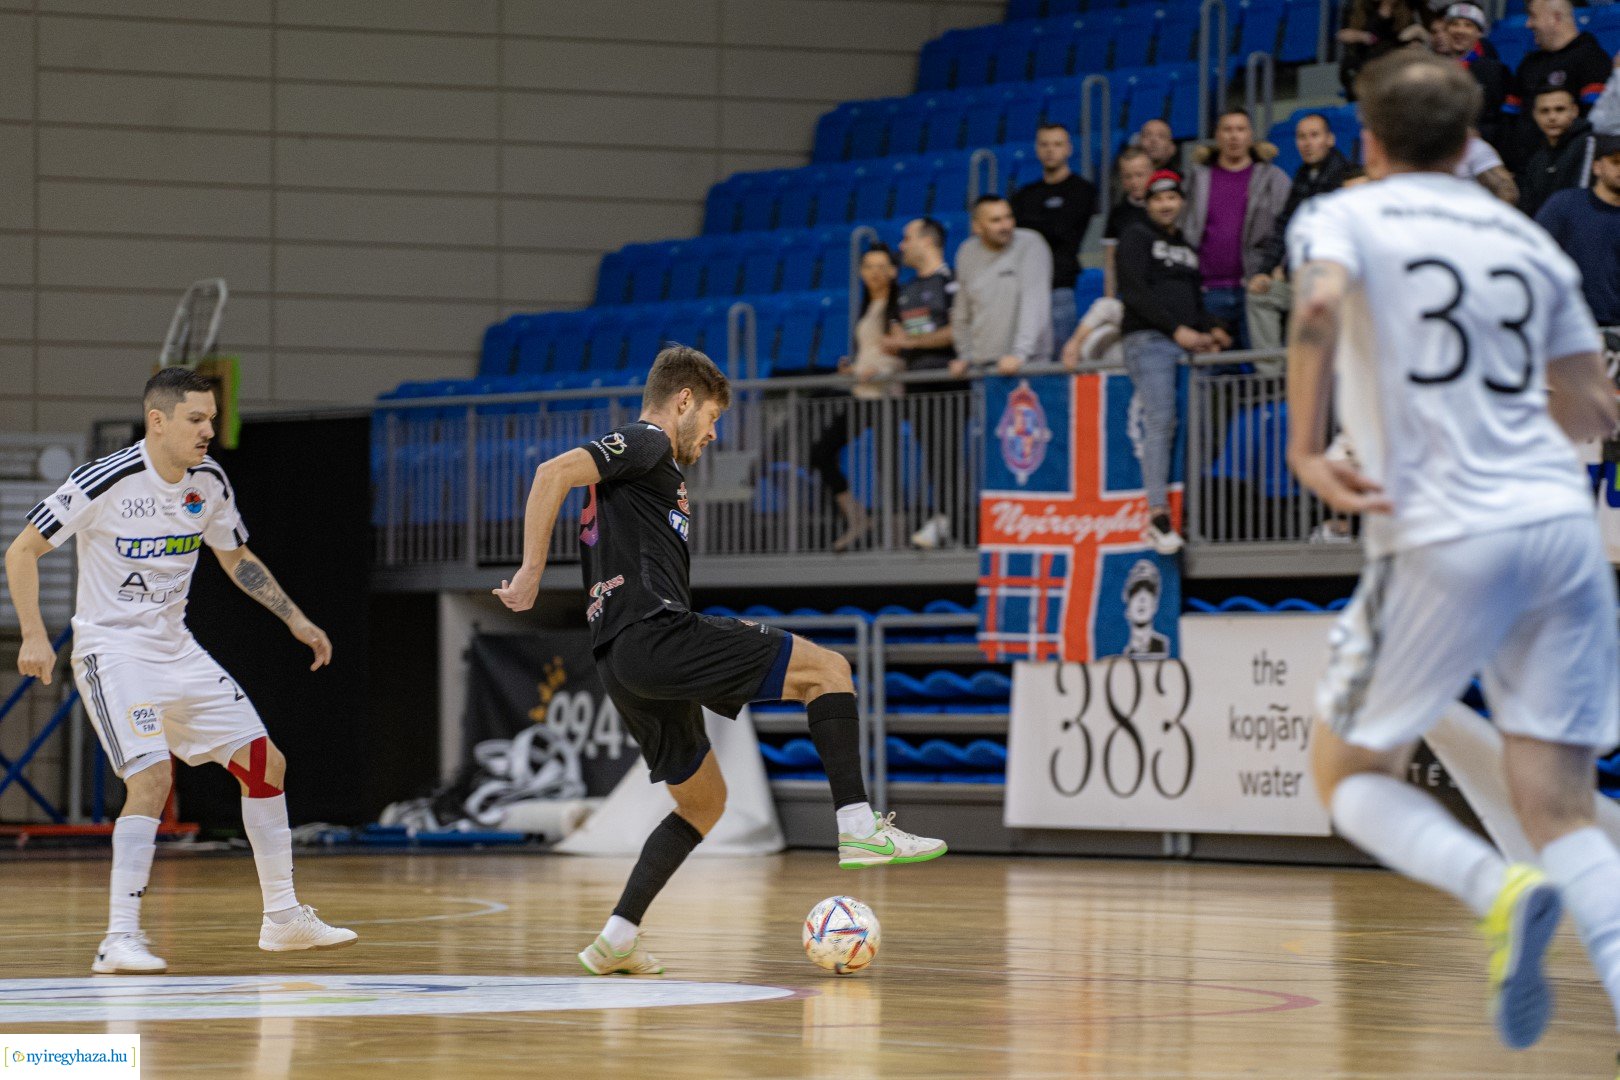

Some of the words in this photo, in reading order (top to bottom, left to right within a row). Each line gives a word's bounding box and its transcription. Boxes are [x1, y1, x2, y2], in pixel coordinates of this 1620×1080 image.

[1404, 257, 1534, 394] 33
[121, 497, 156, 519] 383
[1252, 650, 1287, 685] the
[1050, 656, 1194, 799] 383
[1239, 766, 1303, 797] water
